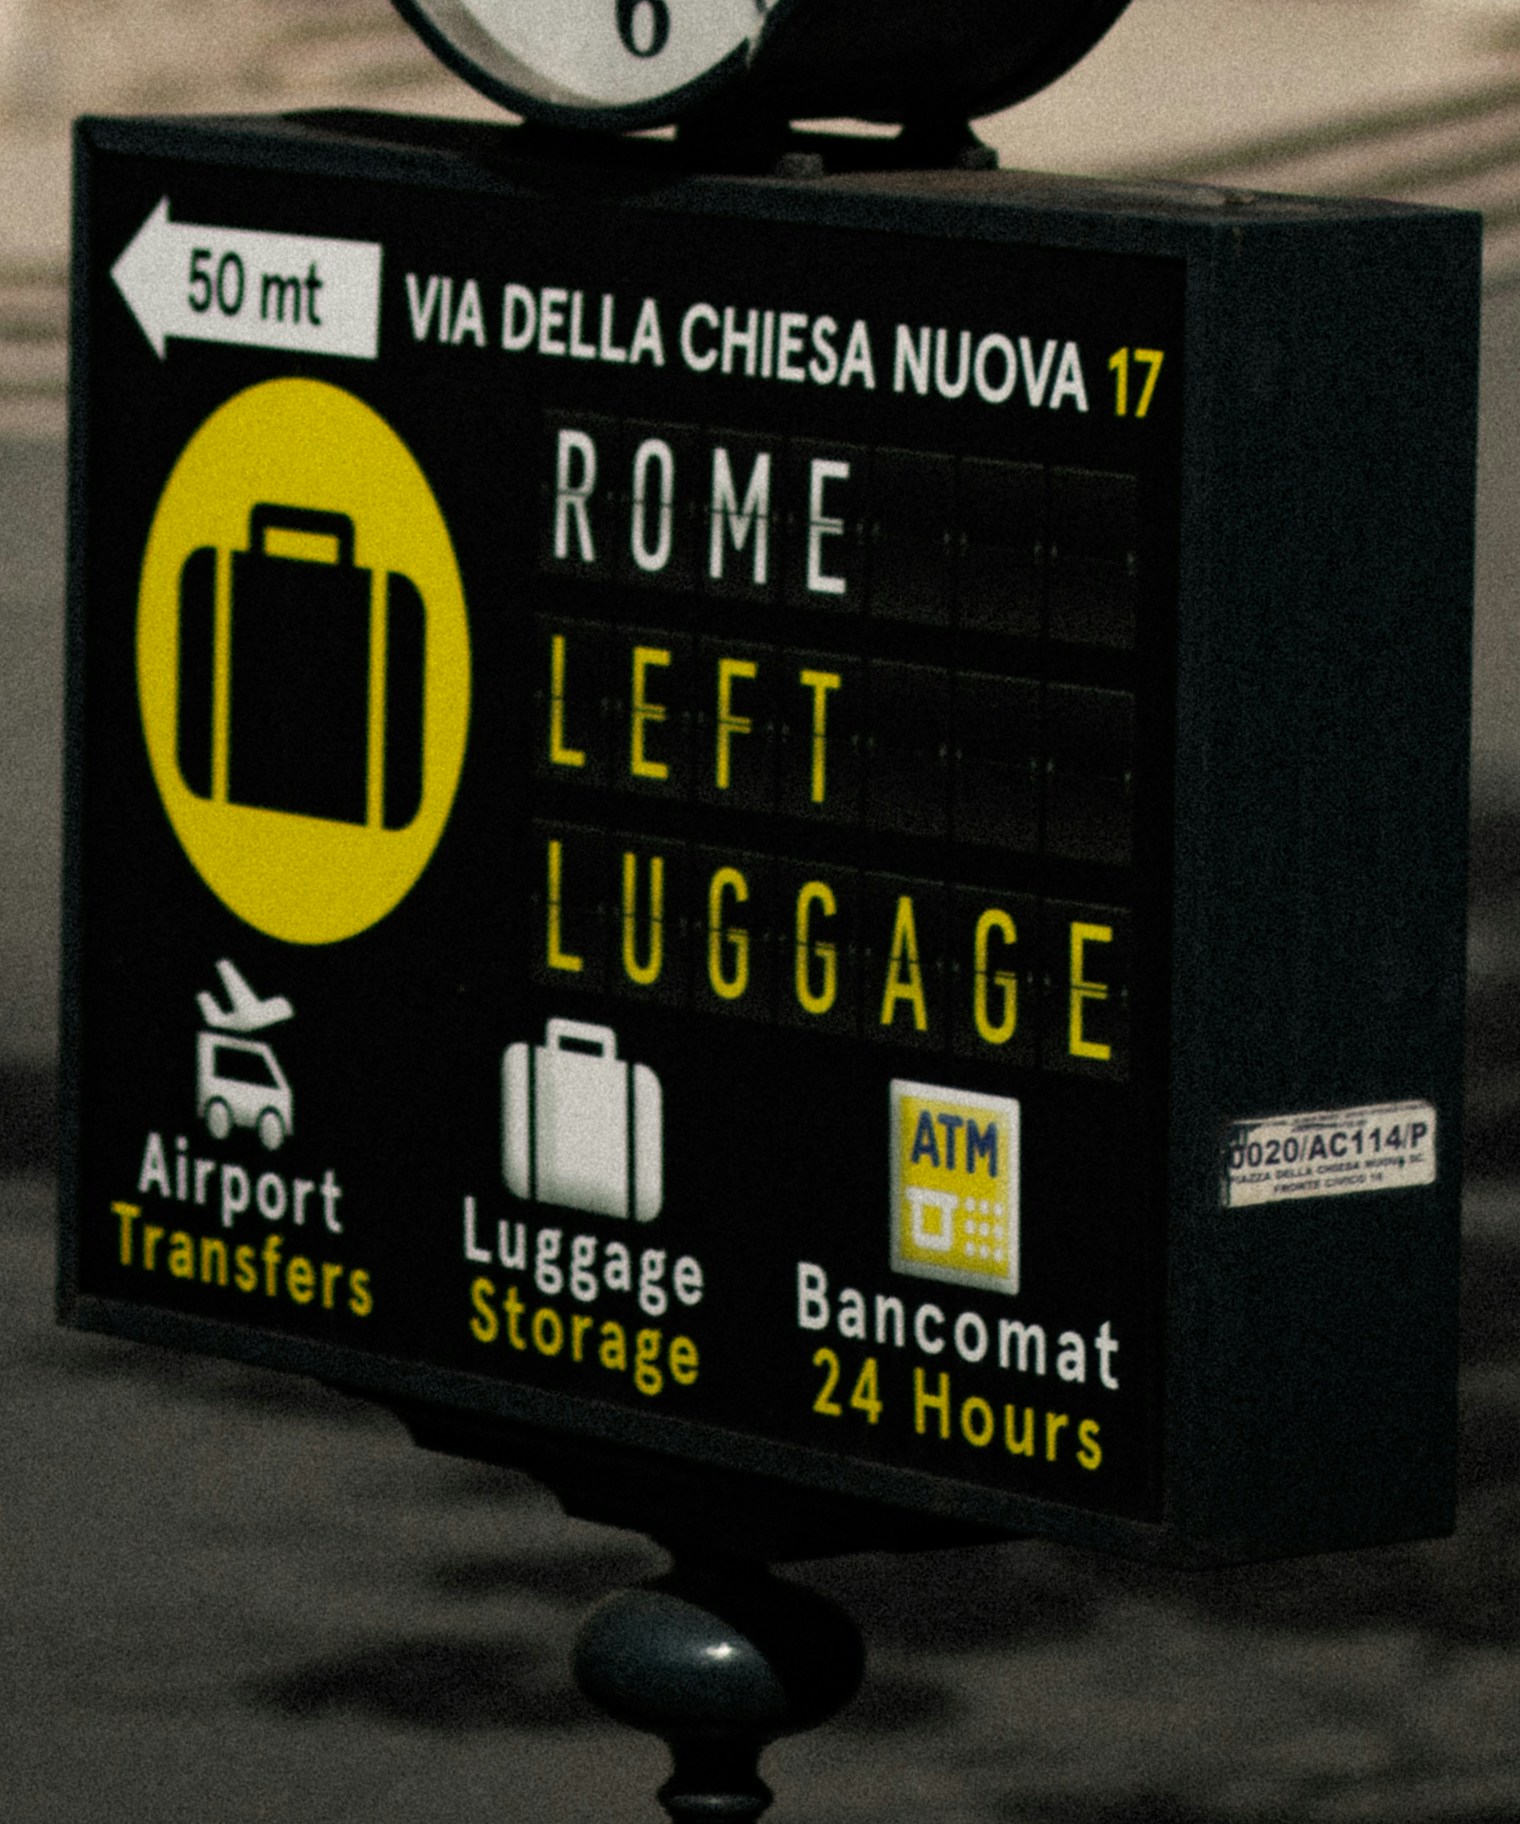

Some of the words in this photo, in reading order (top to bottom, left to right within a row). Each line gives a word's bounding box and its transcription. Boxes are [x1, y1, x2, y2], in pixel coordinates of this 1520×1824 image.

[187, 247, 246, 317] 50
[261, 260, 323, 326] mt
[405, 272, 486, 348] VIA
[501, 282, 665, 367] DELLA
[681, 302, 876, 390] CHIESA
[893, 323, 1090, 413] NUOVA
[1108, 346, 1165, 419] 17
[554, 428, 851, 595] ROME
[550, 634, 842, 804] LEFT
[546, 839, 1114, 1062] LUGGAGE
[138, 1131, 343, 1234] Airport
[911, 1110, 998, 1178] ATM
[111, 1200, 374, 1317] Transfers
[463, 1195, 704, 1316] Luggage
[470, 1277, 699, 1396] Storage
[797, 1260, 1121, 1391] Bancomat
[812, 1346, 883, 1426] 24
[913, 1366, 1104, 1471] Hours
